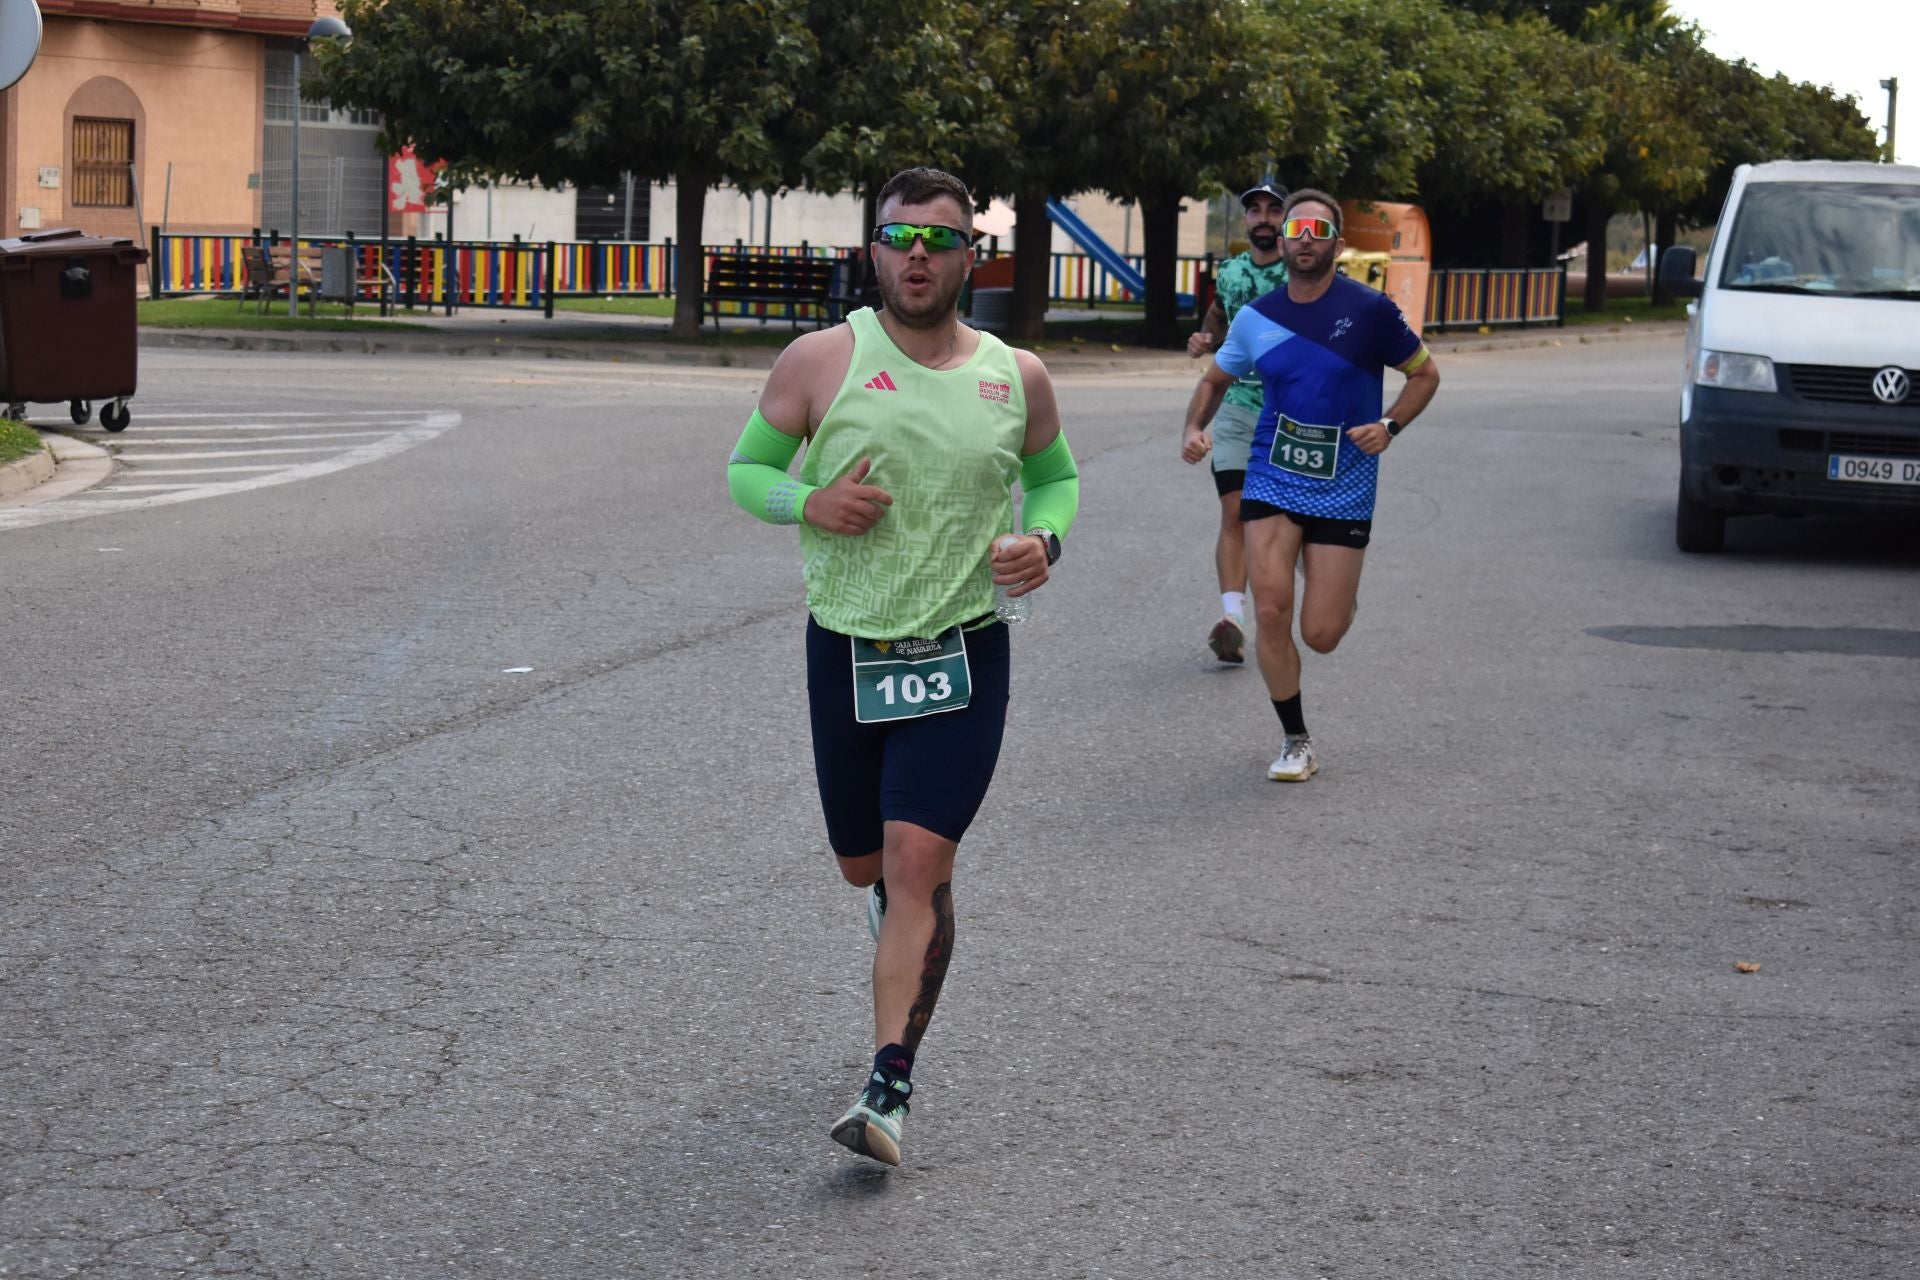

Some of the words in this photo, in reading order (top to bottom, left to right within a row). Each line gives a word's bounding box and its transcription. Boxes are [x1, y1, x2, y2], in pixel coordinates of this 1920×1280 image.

[979, 381, 999, 390] BMW
[979, 388, 999, 396] BERLIN
[979, 394, 1009, 404] MARATHON
[1281, 443, 1324, 469] 193
[1845, 460, 1893, 479] 0949
[906, 643, 942, 655] NAVARRA
[876, 671, 952, 705] 103
